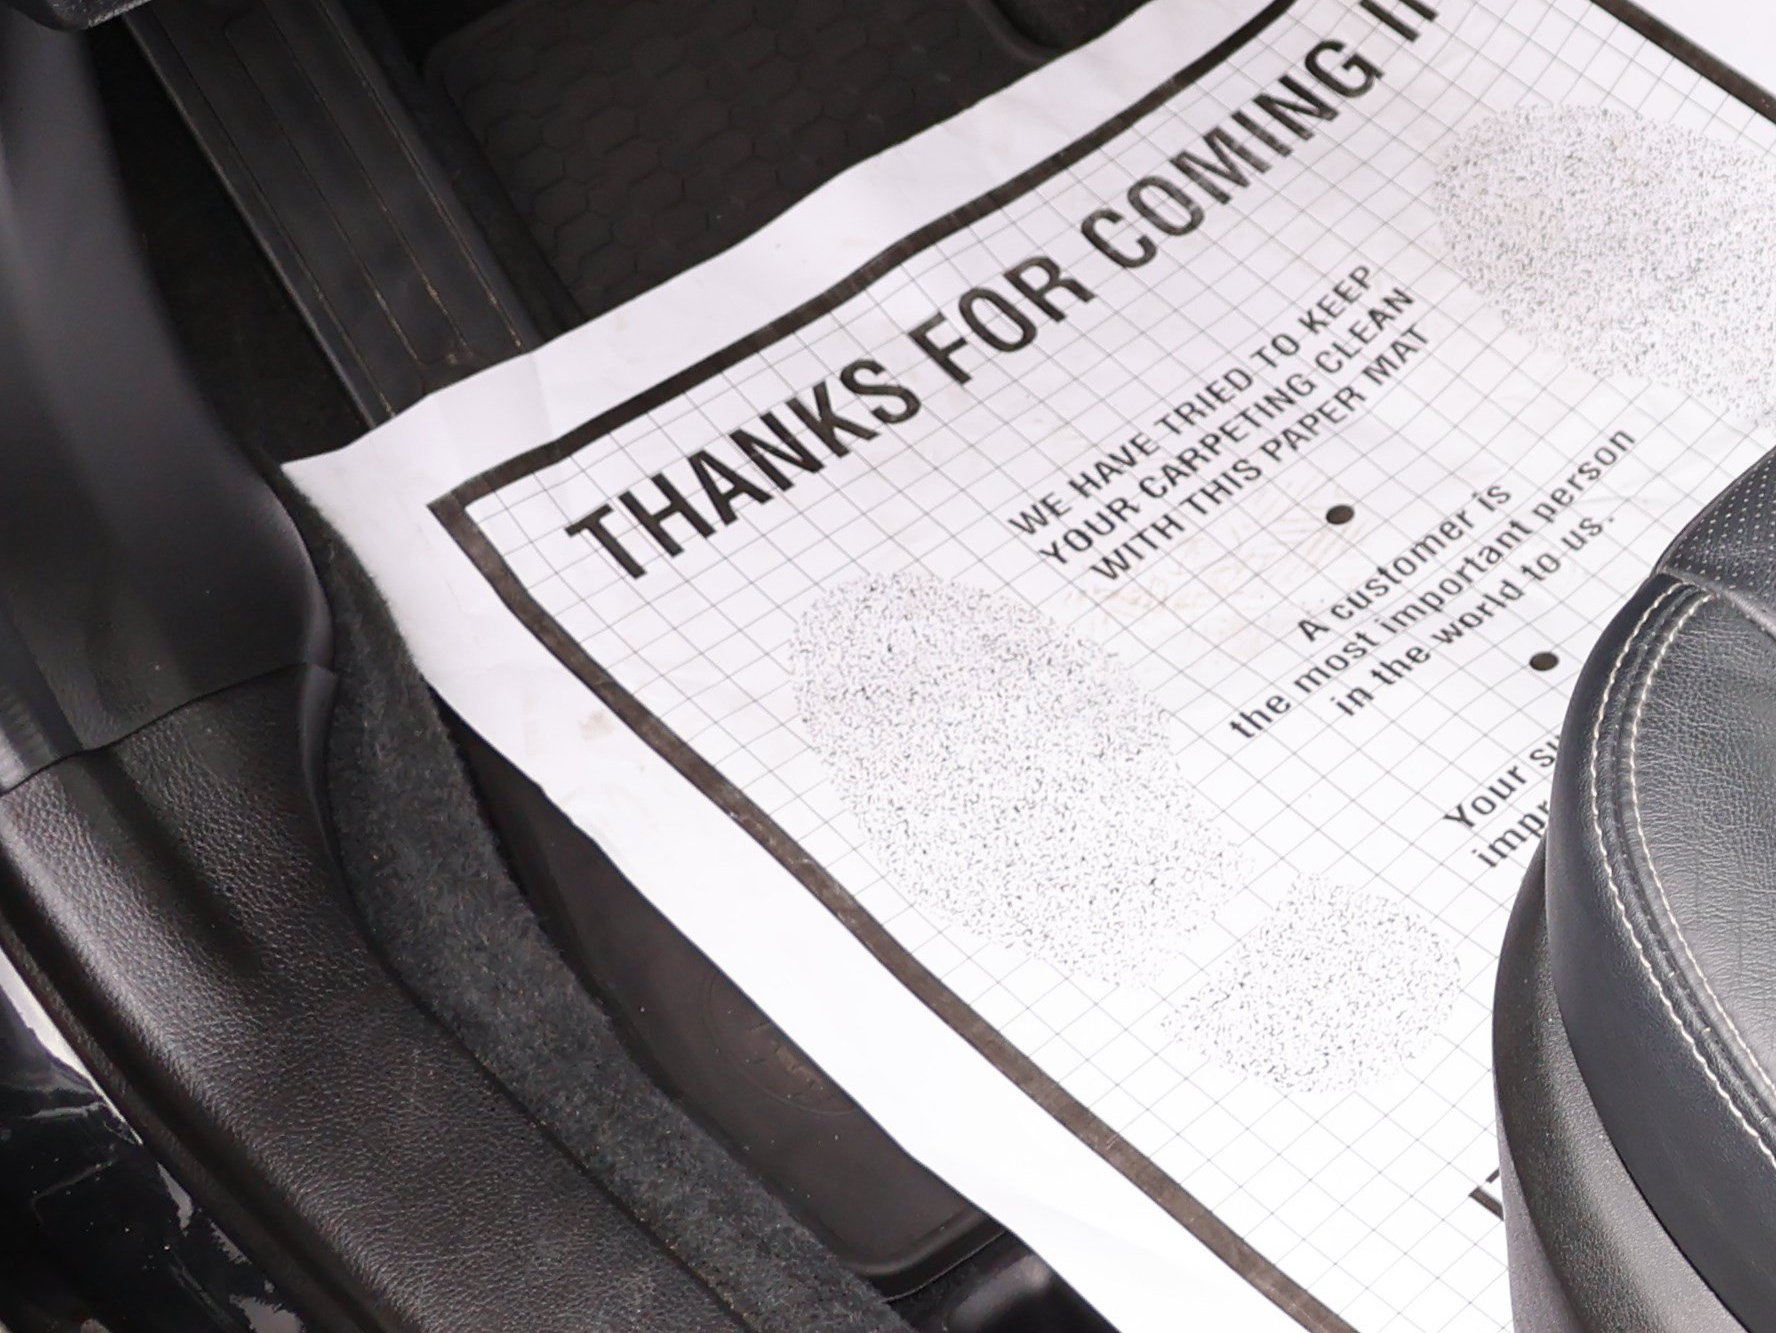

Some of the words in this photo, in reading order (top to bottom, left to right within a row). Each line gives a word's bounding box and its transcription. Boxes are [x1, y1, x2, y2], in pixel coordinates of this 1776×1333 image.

[564, 359, 921, 579] THANKS
[907, 255, 1097, 385] FOR
[1080, 39, 1386, 269] COMING
[1008, 491, 1073, 537] WE
[1067, 432, 1161, 500] HAVE
[1154, 367, 1255, 437] TRIED
[1250, 333, 1300, 370] TO
[1297, 264, 1373, 336] KEEP
[1039, 496, 1141, 568] YOUR
[1138, 372, 1318, 500] CARPETING
[1314, 286, 1417, 375] CLEAN
[1090, 513, 1187, 583] WITH
[1180, 458, 1263, 519] THIS
[1260, 385, 1368, 464] PAPER
[1362, 323, 1431, 387] MAT
[1229, 693, 1292, 740] the
[1293, 630, 1381, 695] most
[1378, 518, 1533, 636] important
[1531, 427, 1637, 524] person
[1296, 618, 1331, 643] A
[1329, 507, 1476, 623] customer
[1471, 483, 1512, 513] is
[1329, 685, 1375, 717] in
[1370, 646, 1433, 686] the
[1431, 580, 1525, 646] world
[1520, 550, 1562, 584] to
[1562, 514, 1617, 553] us.
[1443, 764, 1528, 830] Your
